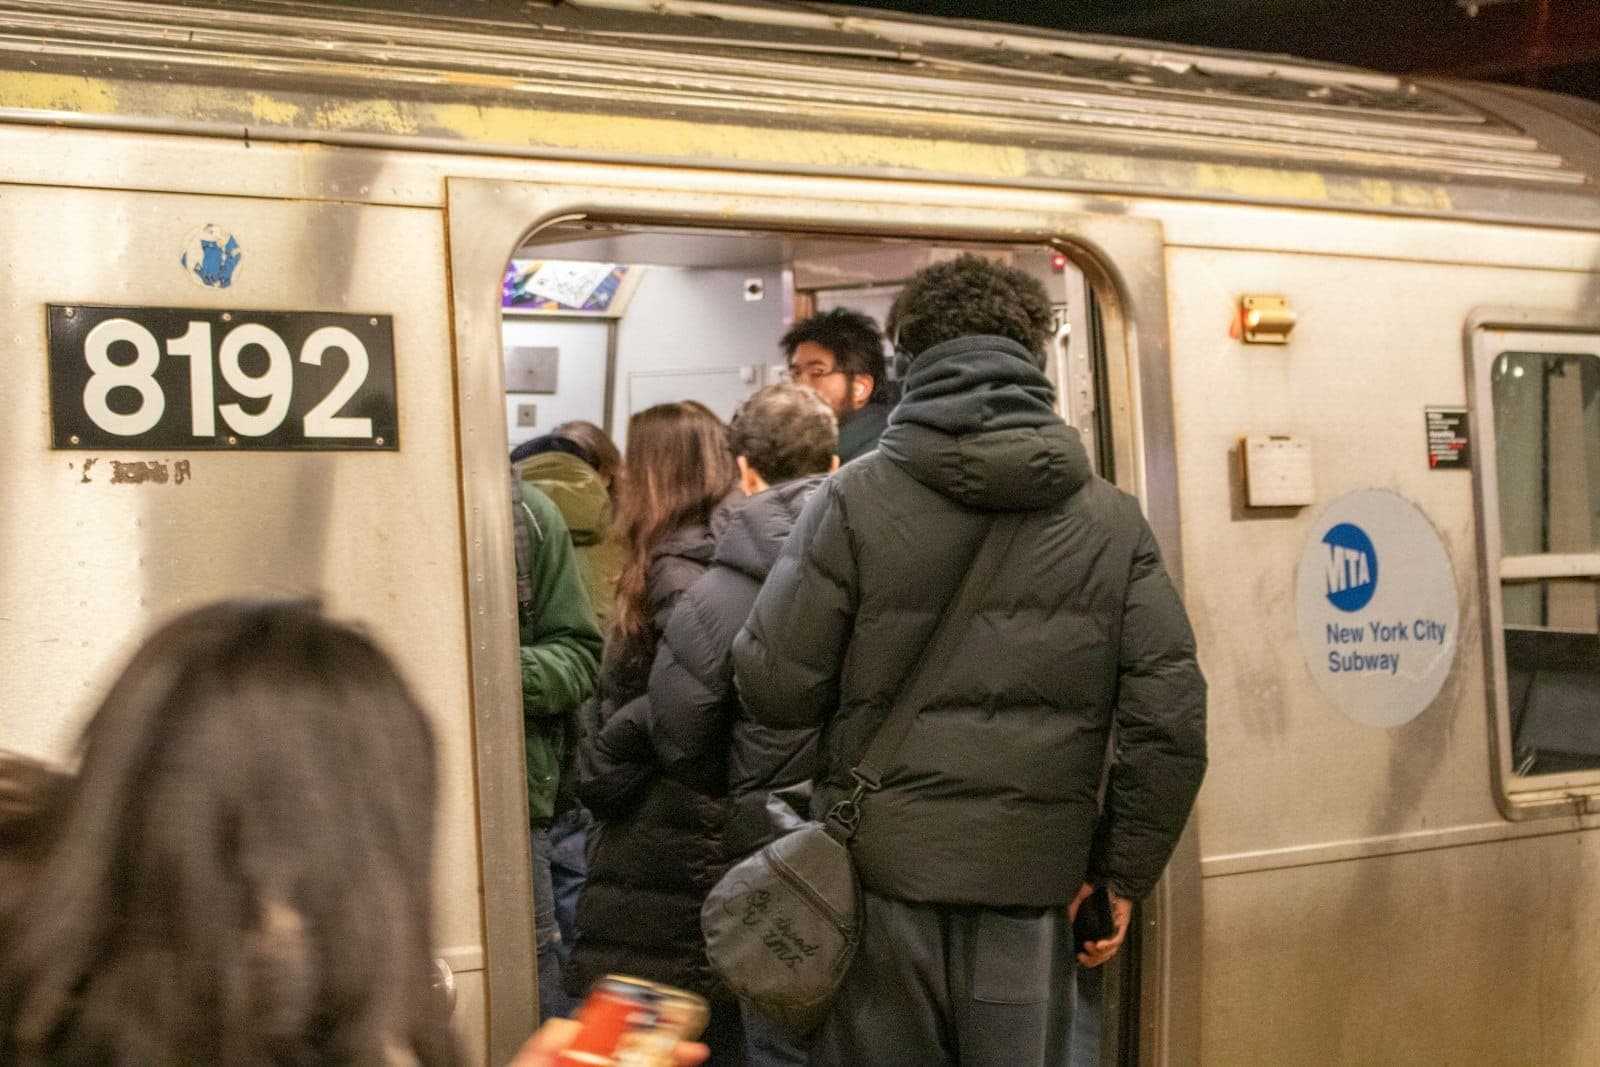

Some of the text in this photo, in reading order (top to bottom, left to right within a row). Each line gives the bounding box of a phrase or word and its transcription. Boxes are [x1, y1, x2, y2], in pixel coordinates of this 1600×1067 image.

[83, 318, 373, 438] 8192
[1321, 543, 1371, 594] MTA
[1326, 619, 1447, 645] New York City
[1328, 651, 1400, 675] Subway
